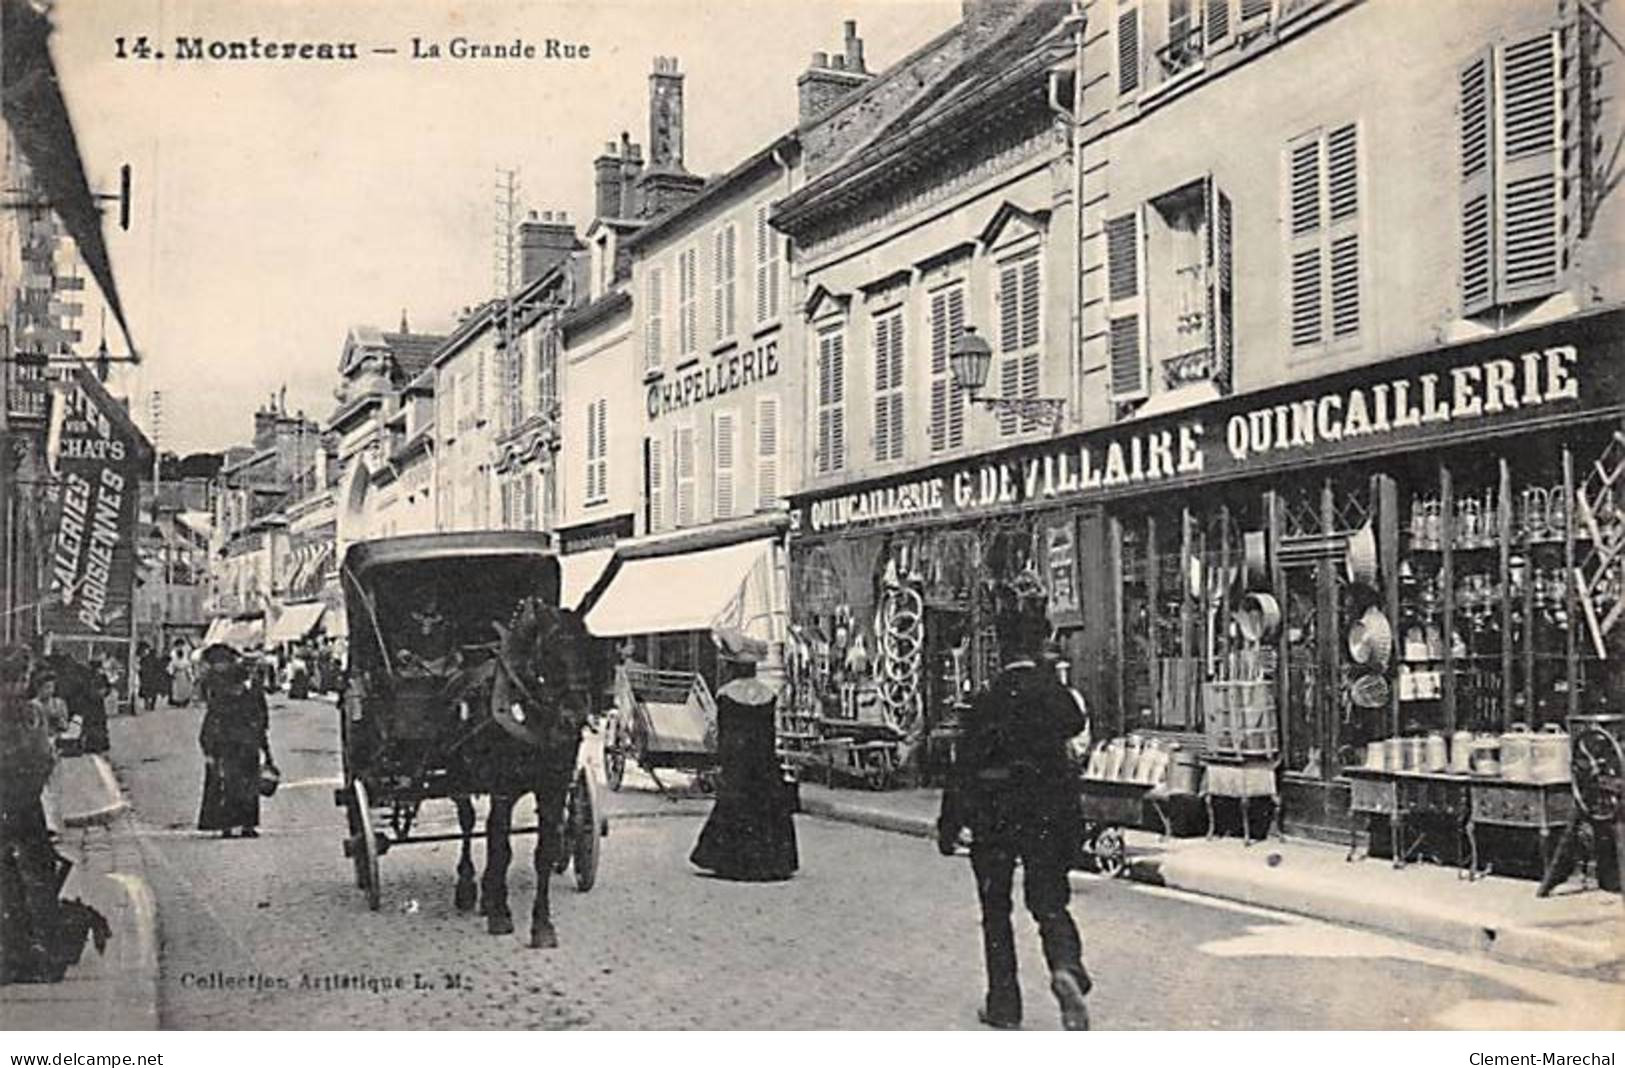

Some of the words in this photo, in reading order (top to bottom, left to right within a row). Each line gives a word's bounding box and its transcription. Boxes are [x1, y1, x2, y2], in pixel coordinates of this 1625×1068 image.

[647, 341, 778, 421] CHAPELLERIE
[811, 478, 943, 531] QUINCAILLERIE
[1227, 346, 1579, 459] QUINCAILLERIE
[60, 439, 125, 460] CHATS
[51, 473, 91, 604] ALERIES
[79, 468, 125, 632] PARISIENNES
